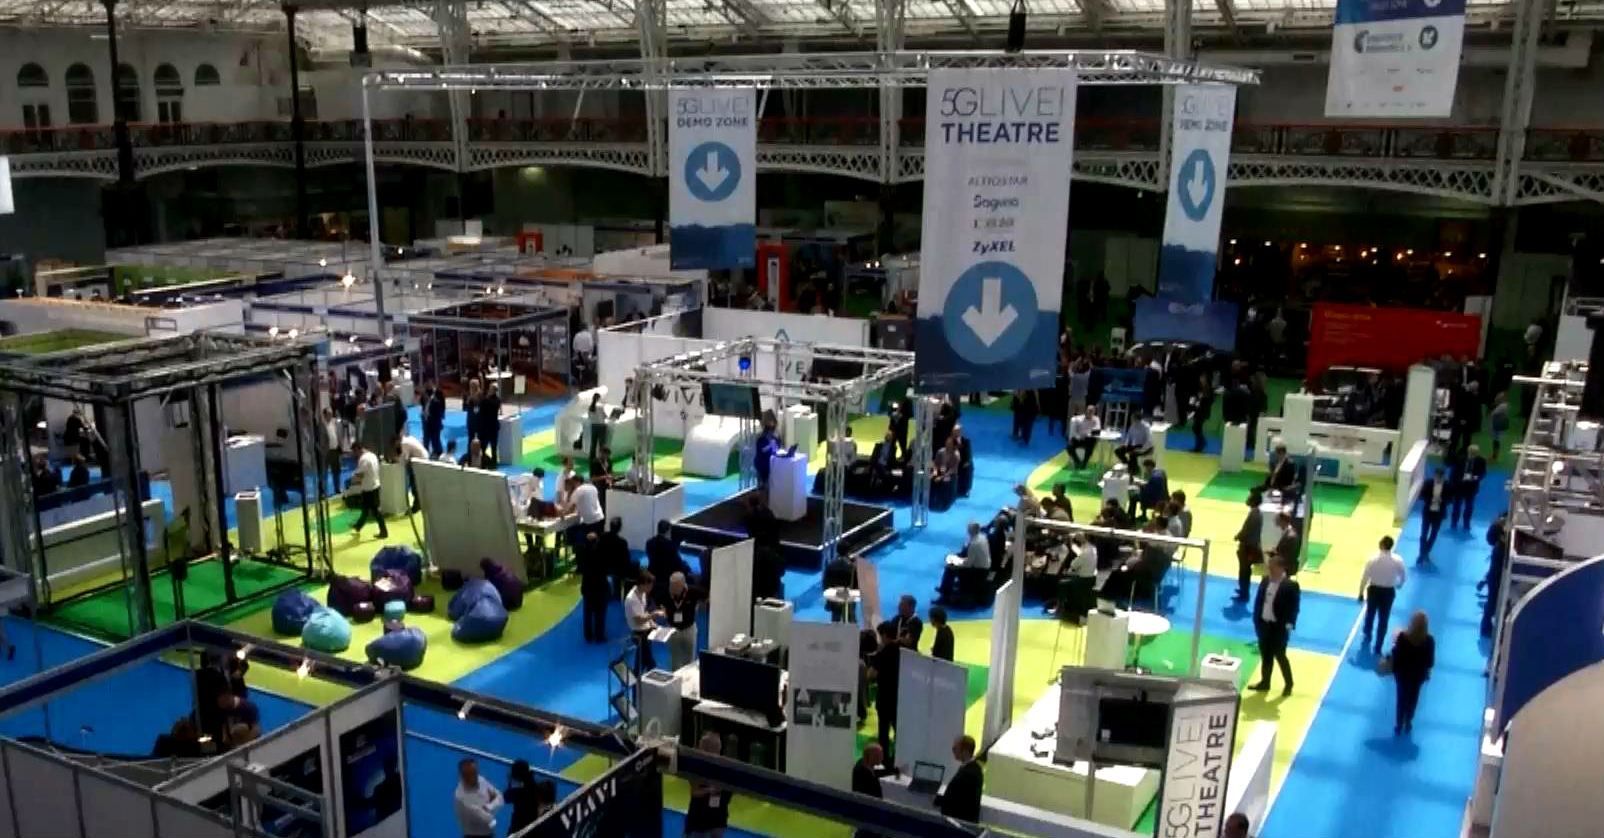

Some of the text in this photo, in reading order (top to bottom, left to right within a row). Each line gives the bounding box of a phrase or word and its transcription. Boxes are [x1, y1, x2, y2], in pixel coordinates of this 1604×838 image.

[940, 87, 1064, 116] 5GLIVE!
[677, 116, 749, 128] DEMO ZONE
[940, 121, 1060, 143] THEATRE
[972, 240, 1015, 255] ZyXEL
[1194, 713, 1228, 837] THEATRE
